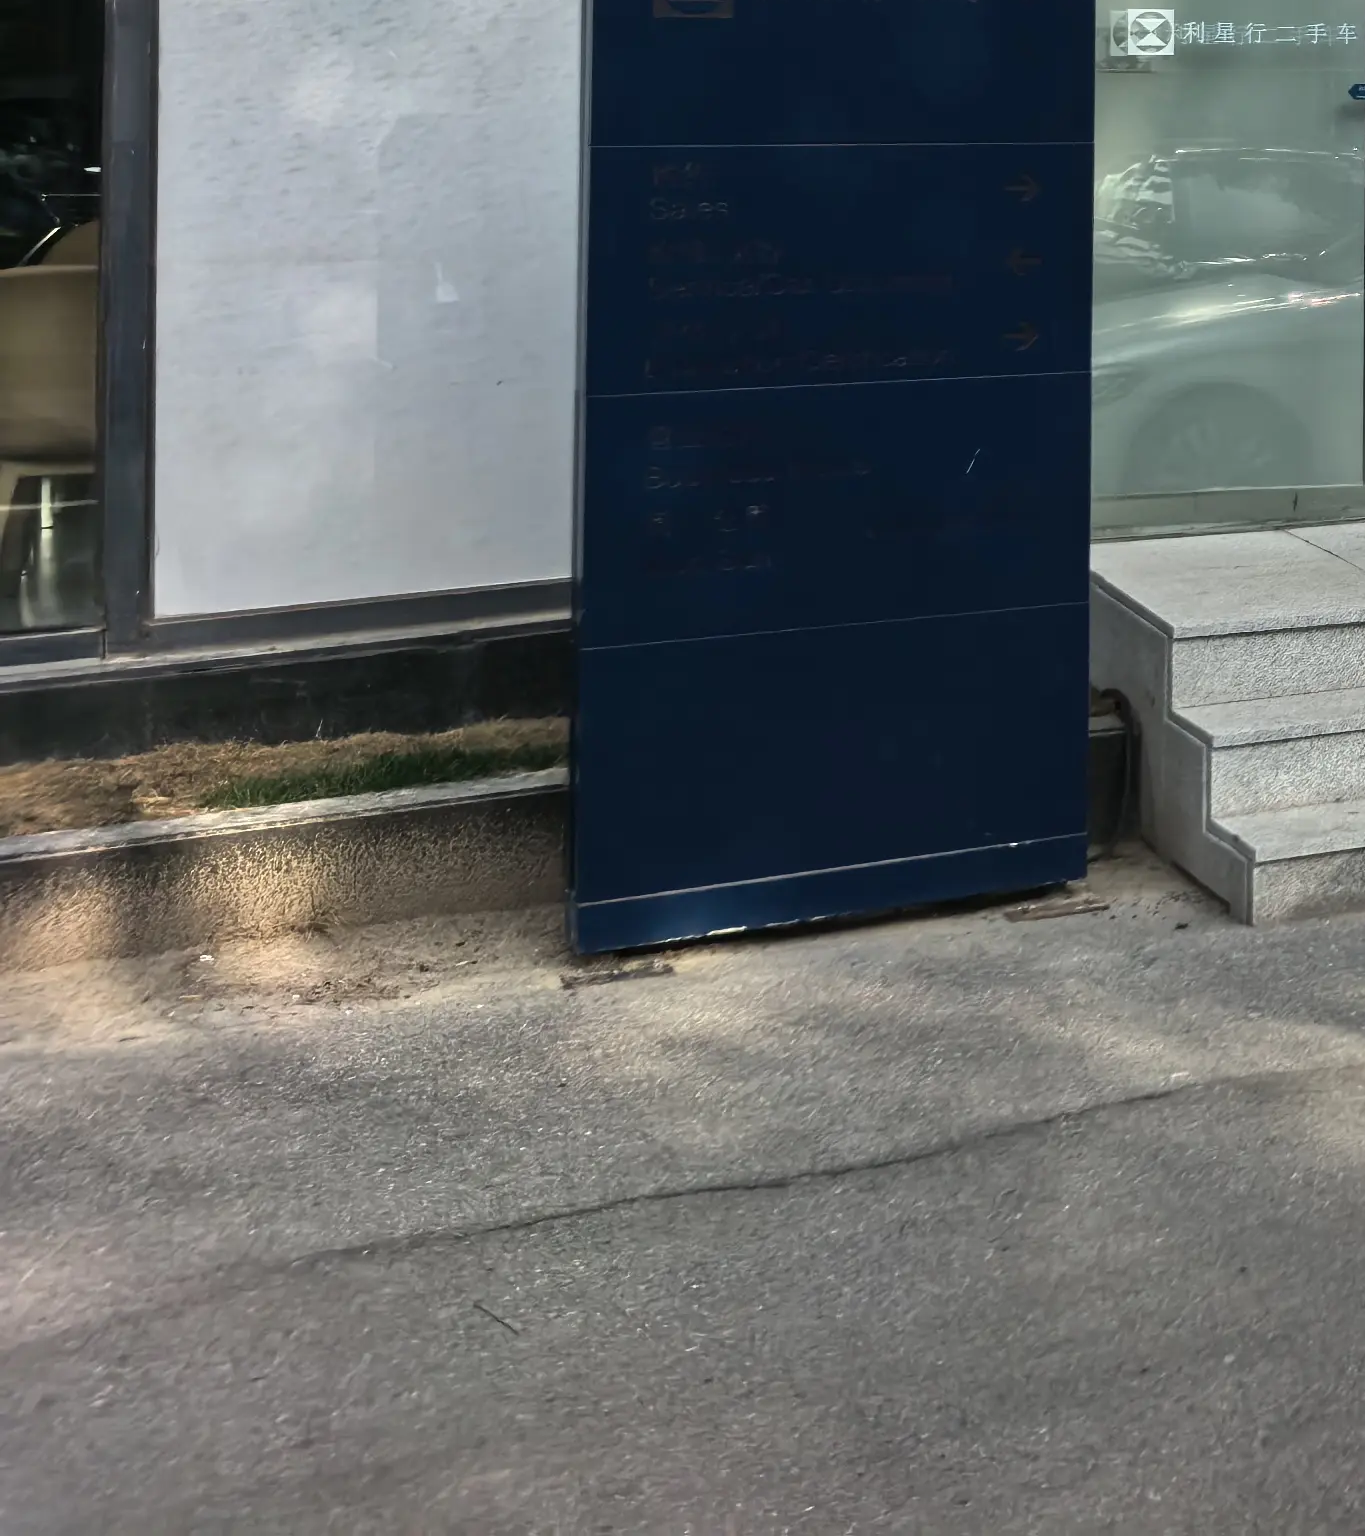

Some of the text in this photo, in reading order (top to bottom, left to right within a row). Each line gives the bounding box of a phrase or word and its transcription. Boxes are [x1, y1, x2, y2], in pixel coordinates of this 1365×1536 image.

[1183, 20, 1358, 45] 利星行二手车
